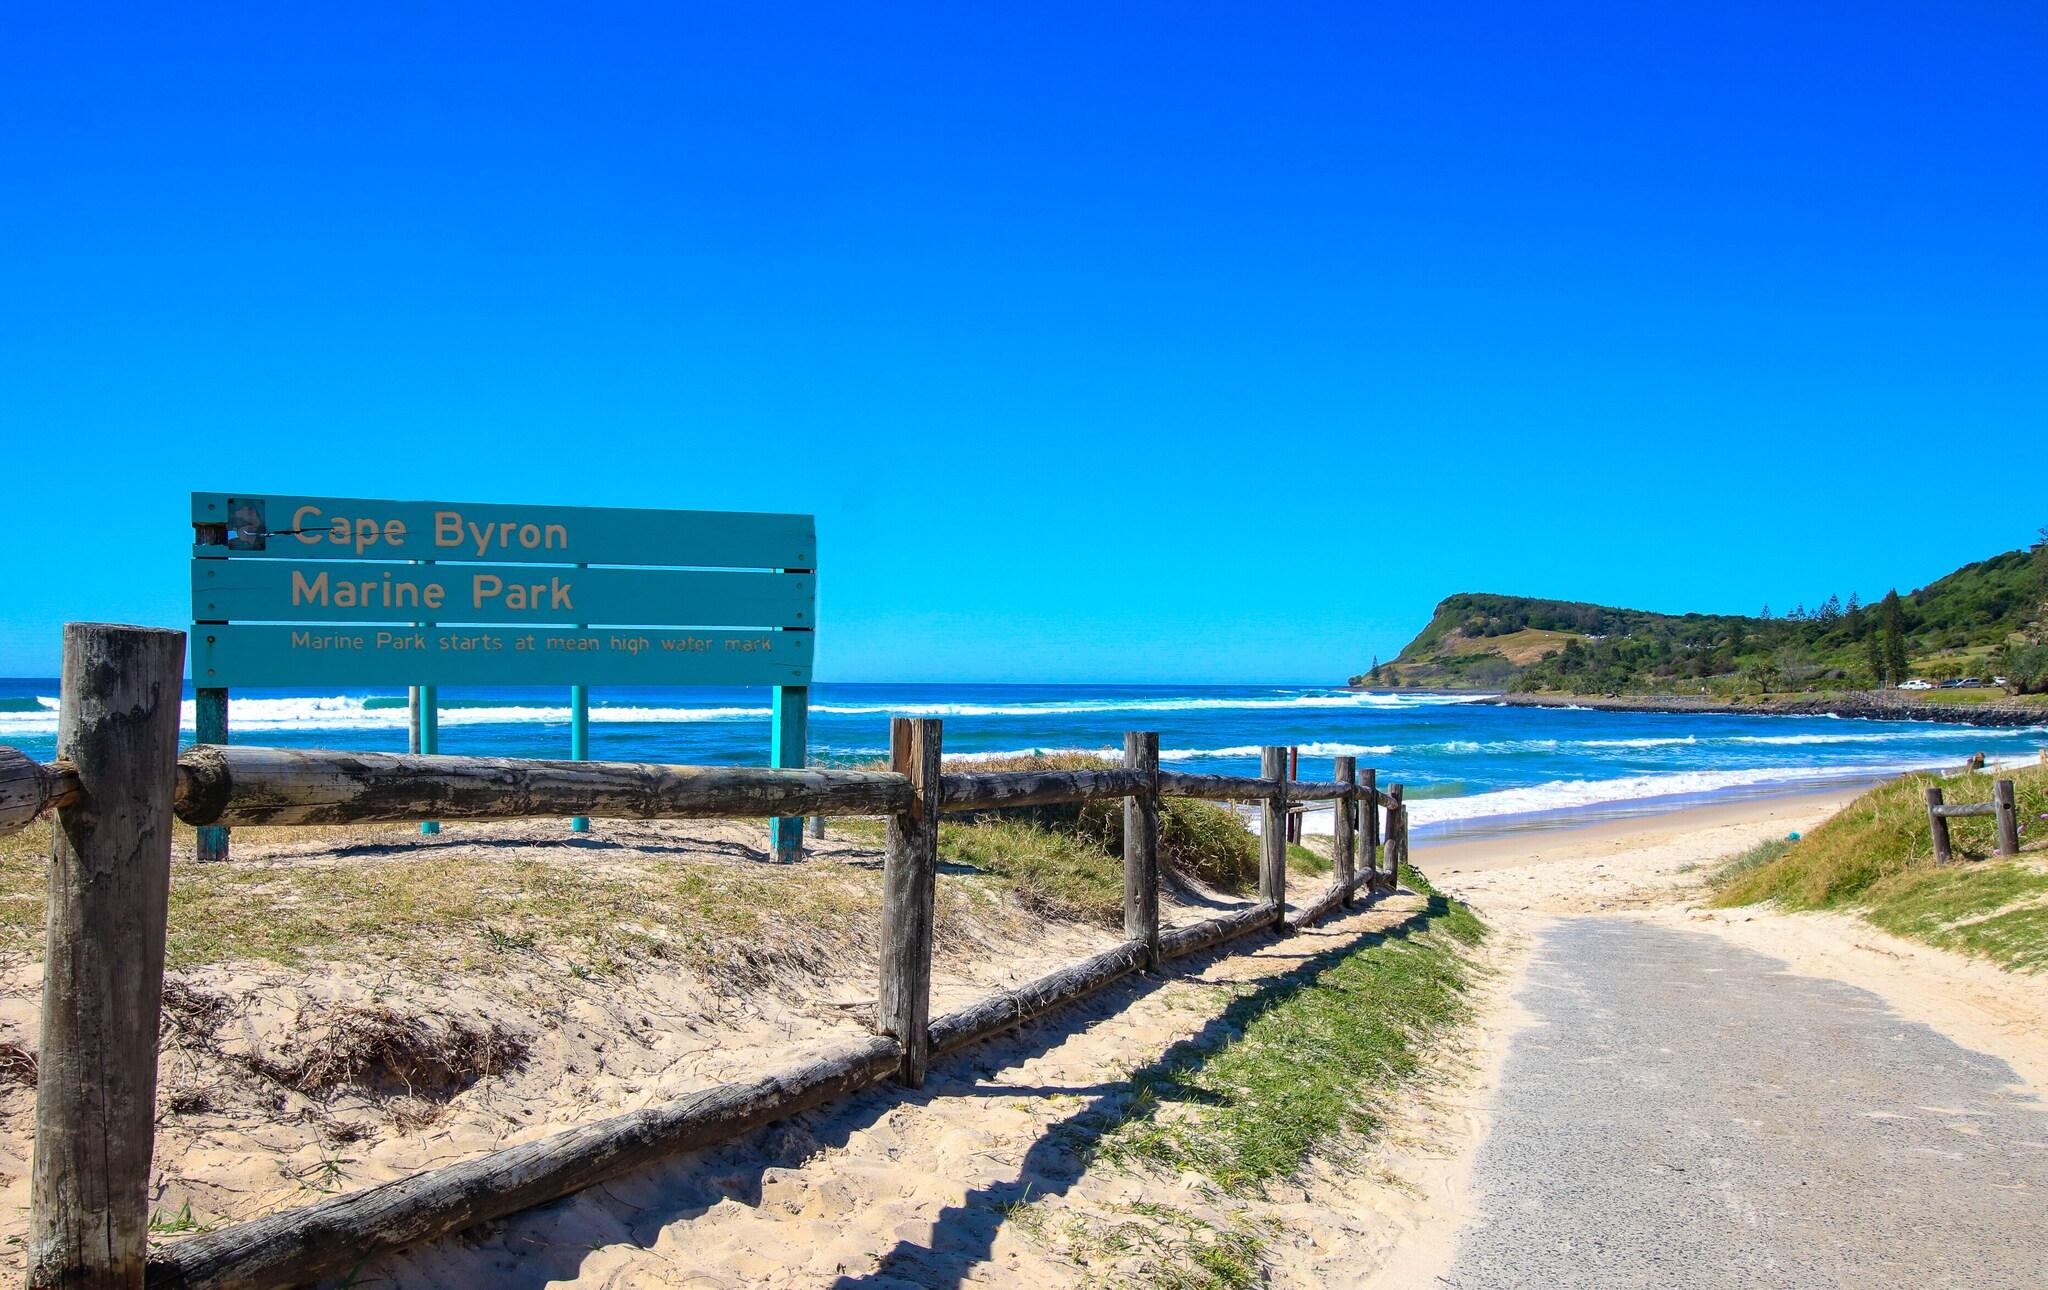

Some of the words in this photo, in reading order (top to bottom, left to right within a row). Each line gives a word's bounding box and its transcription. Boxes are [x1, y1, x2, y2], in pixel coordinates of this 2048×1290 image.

[292, 505, 407, 555] Cape
[434, 511, 568, 557] Byron
[292, 570, 445, 609] Marine
[472, 574, 573, 610] Park
[291, 631, 364, 650] Marine
[376, 631, 427, 650] Park
[439, 633, 503, 651] starts
[514, 634, 536, 650] at
[546, 637, 600, 651] mean
[610, 634, 650, 655] high
[661, 636, 713, 652] water
[724, 634, 773, 652] mark
